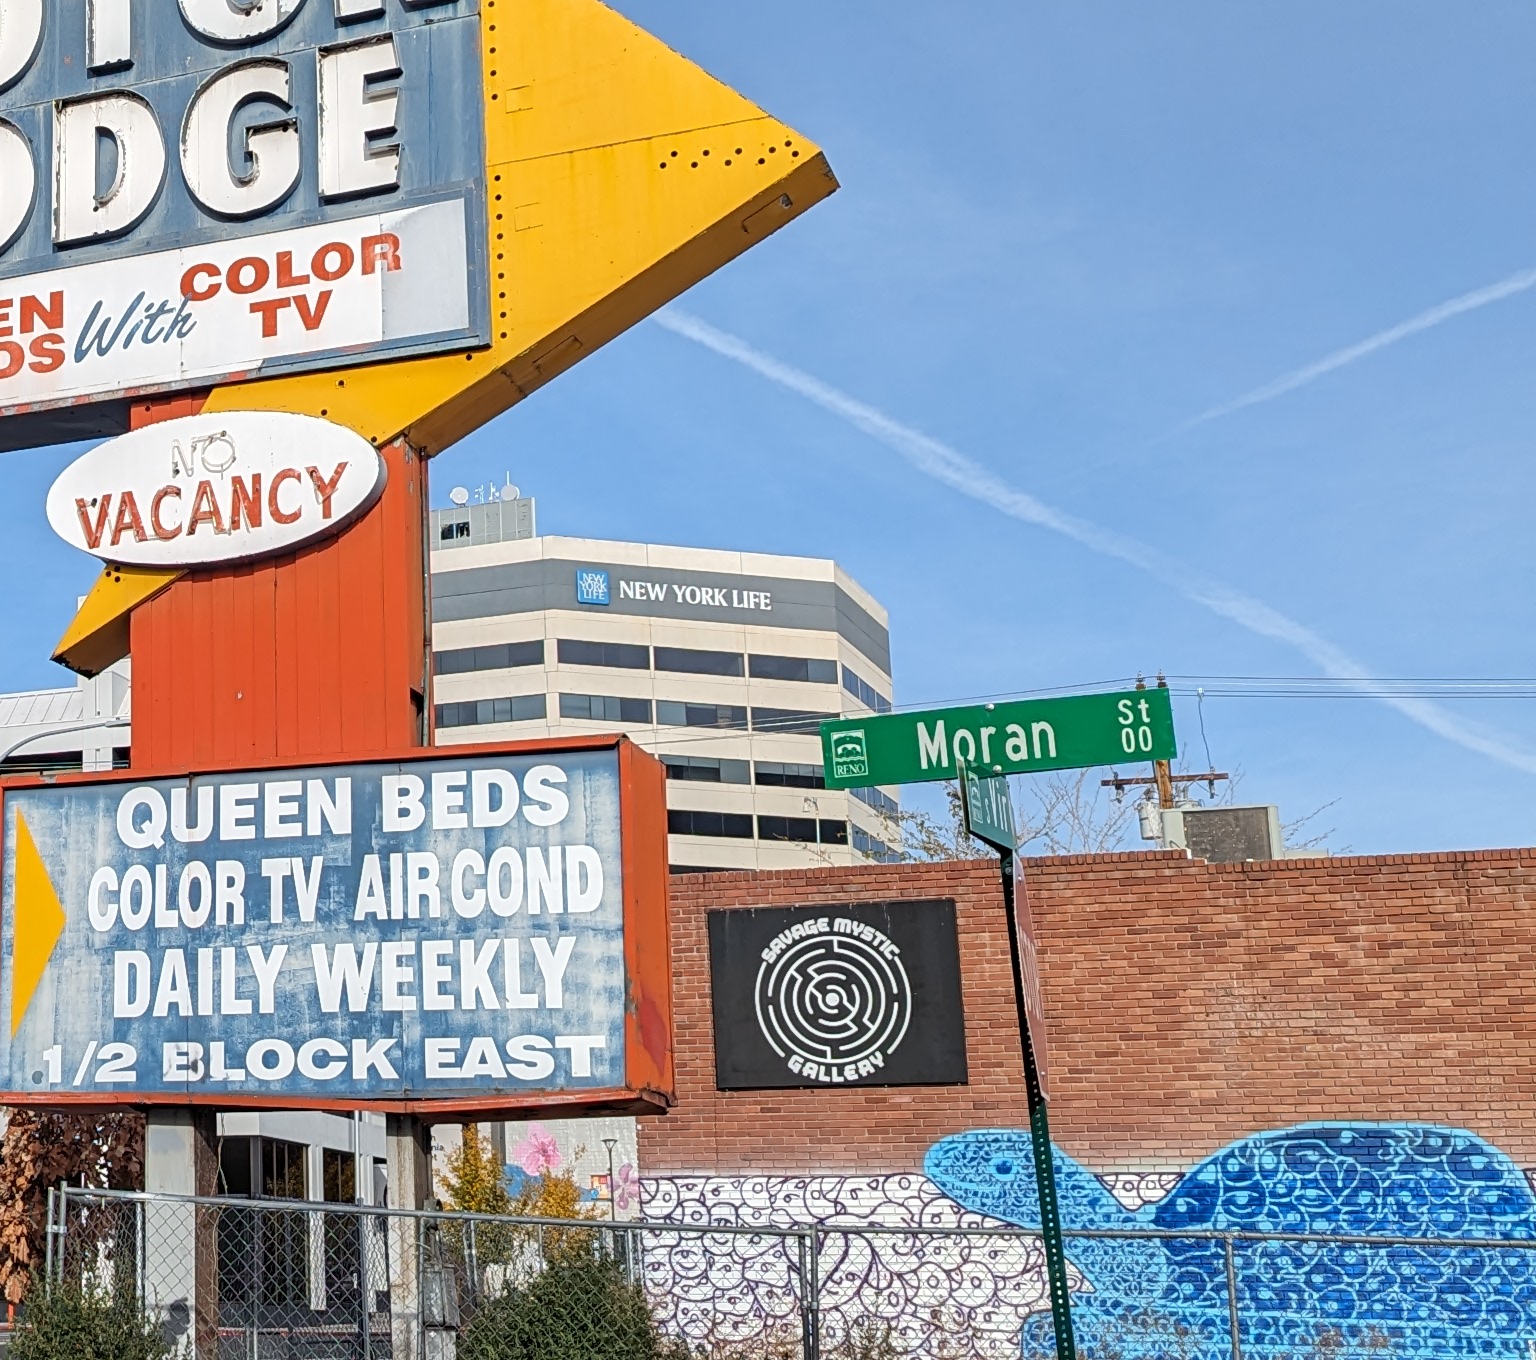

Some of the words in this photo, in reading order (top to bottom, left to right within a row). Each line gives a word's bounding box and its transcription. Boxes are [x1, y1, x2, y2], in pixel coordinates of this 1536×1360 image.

[180, 232, 402, 301] COLOR
[74, 290, 197, 363] With
[249, 289, 333, 338] TV
[171, 430, 237, 478] NO
[75, 461, 349, 549] VACANCY
[579, 579, 607, 592] YORK
[582, 572, 605, 583] NEW
[584, 589, 605, 600] LIFE
[619, 580, 668, 601] NEW
[672, 584, 728, 607] YORK
[732, 590, 772, 611] LIFE
[1118, 698, 1151, 725] St
[916, 719, 1057, 771] Moran
[1121, 726, 1153, 754] 00
[837, 763, 865, 776] RENO
[116, 777, 352, 849] QUEEN
[382, 764, 568, 832] BEDS
[88, 860, 245, 932] COLOR
[261, 855, 323, 925] TV
[353, 851, 441, 921] AIR
[451, 844, 605, 919] COND
[761, 917, 830, 964] SAVAGE
[833, 917, 900, 960] MYSTIC
[113, 944, 288, 1019] DAILY
[311, 936, 577, 1013] WEEKLY
[43, 1041, 137, 1086] 1/2
[163, 1038, 400, 1082] BLOCK
[424, 1035, 607, 1079] EAST
[787, 1050, 885, 1082] GALLERY
